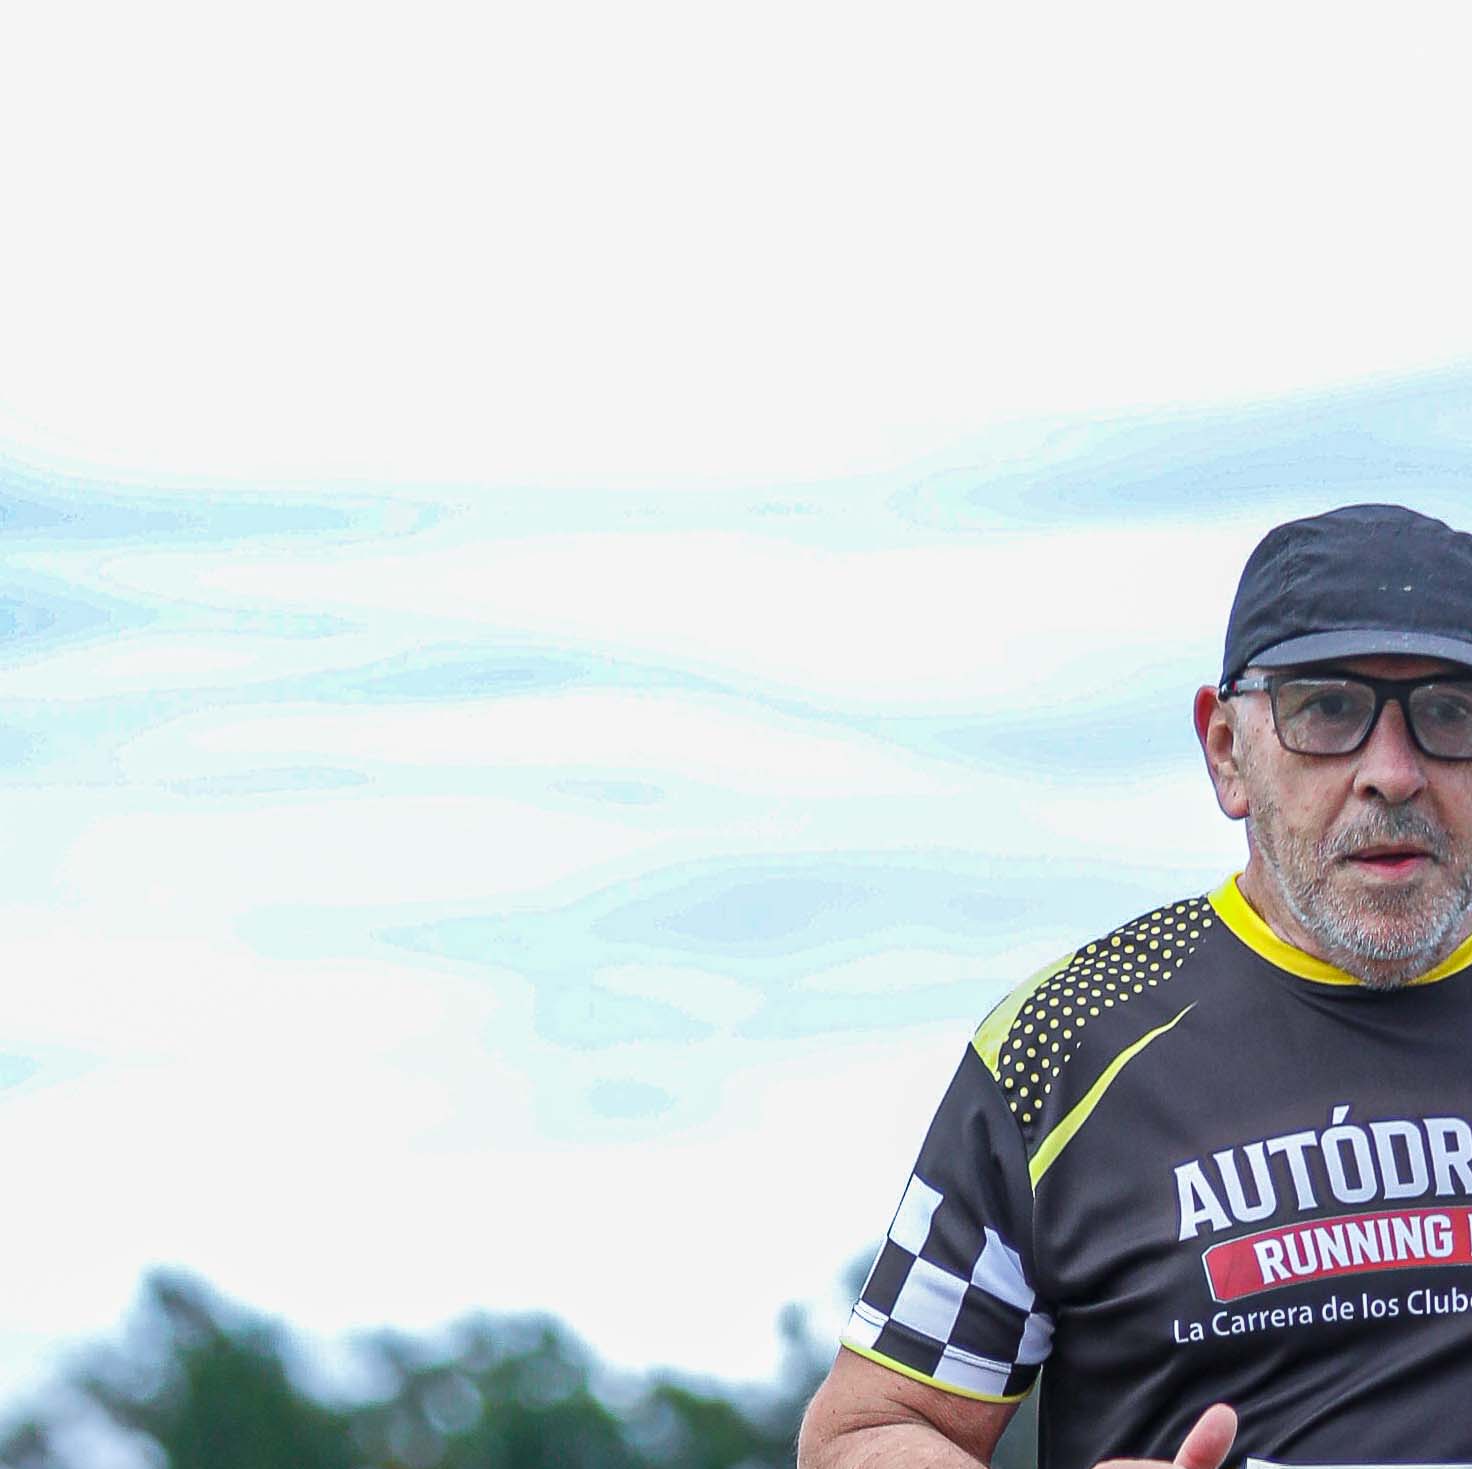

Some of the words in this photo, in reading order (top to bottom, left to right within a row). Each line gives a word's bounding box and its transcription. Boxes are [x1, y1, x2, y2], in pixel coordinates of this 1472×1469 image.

[1253, 1213, 1454, 1286] RUNNING
[1173, 1319, 1205, 1344] La
[1212, 1303, 1313, 1336] Carrera
[1321, 1296, 1354, 1322] de
[1362, 1293, 1399, 1319] los
